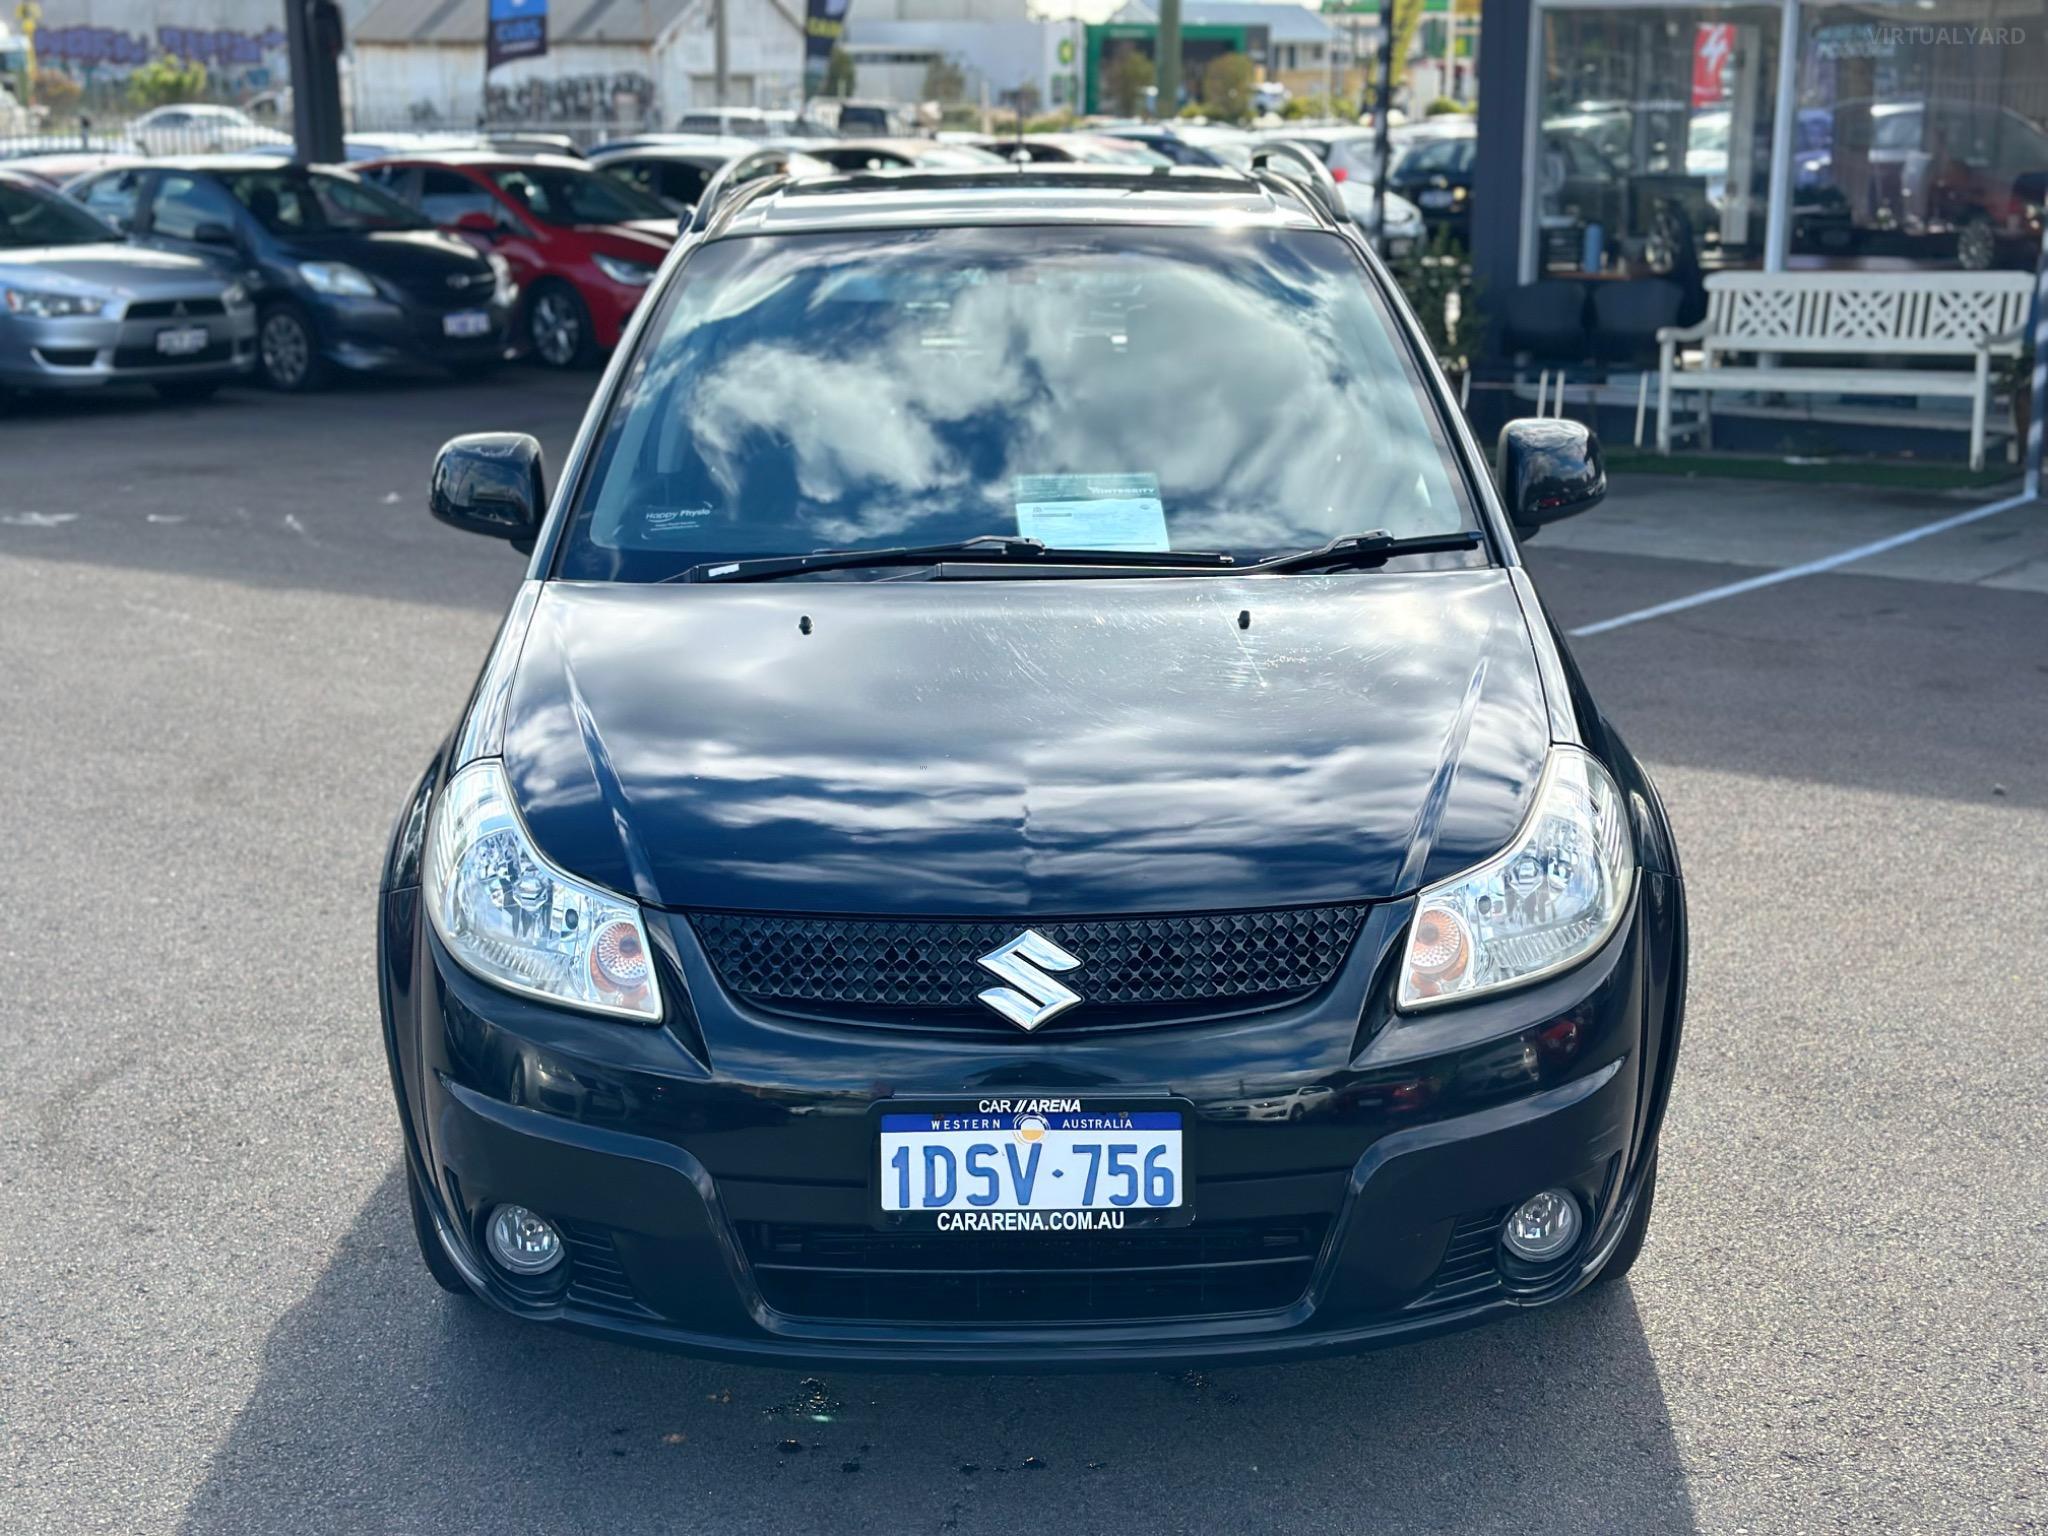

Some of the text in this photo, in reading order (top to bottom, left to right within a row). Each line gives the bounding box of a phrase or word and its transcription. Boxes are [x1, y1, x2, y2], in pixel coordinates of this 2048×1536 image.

[978, 1099, 1011, 1113] CAR
[930, 1119, 1133, 1130] WESTERN AUSTRALIA
[936, 1211, 1125, 1232] CARARENA.COM.AU
